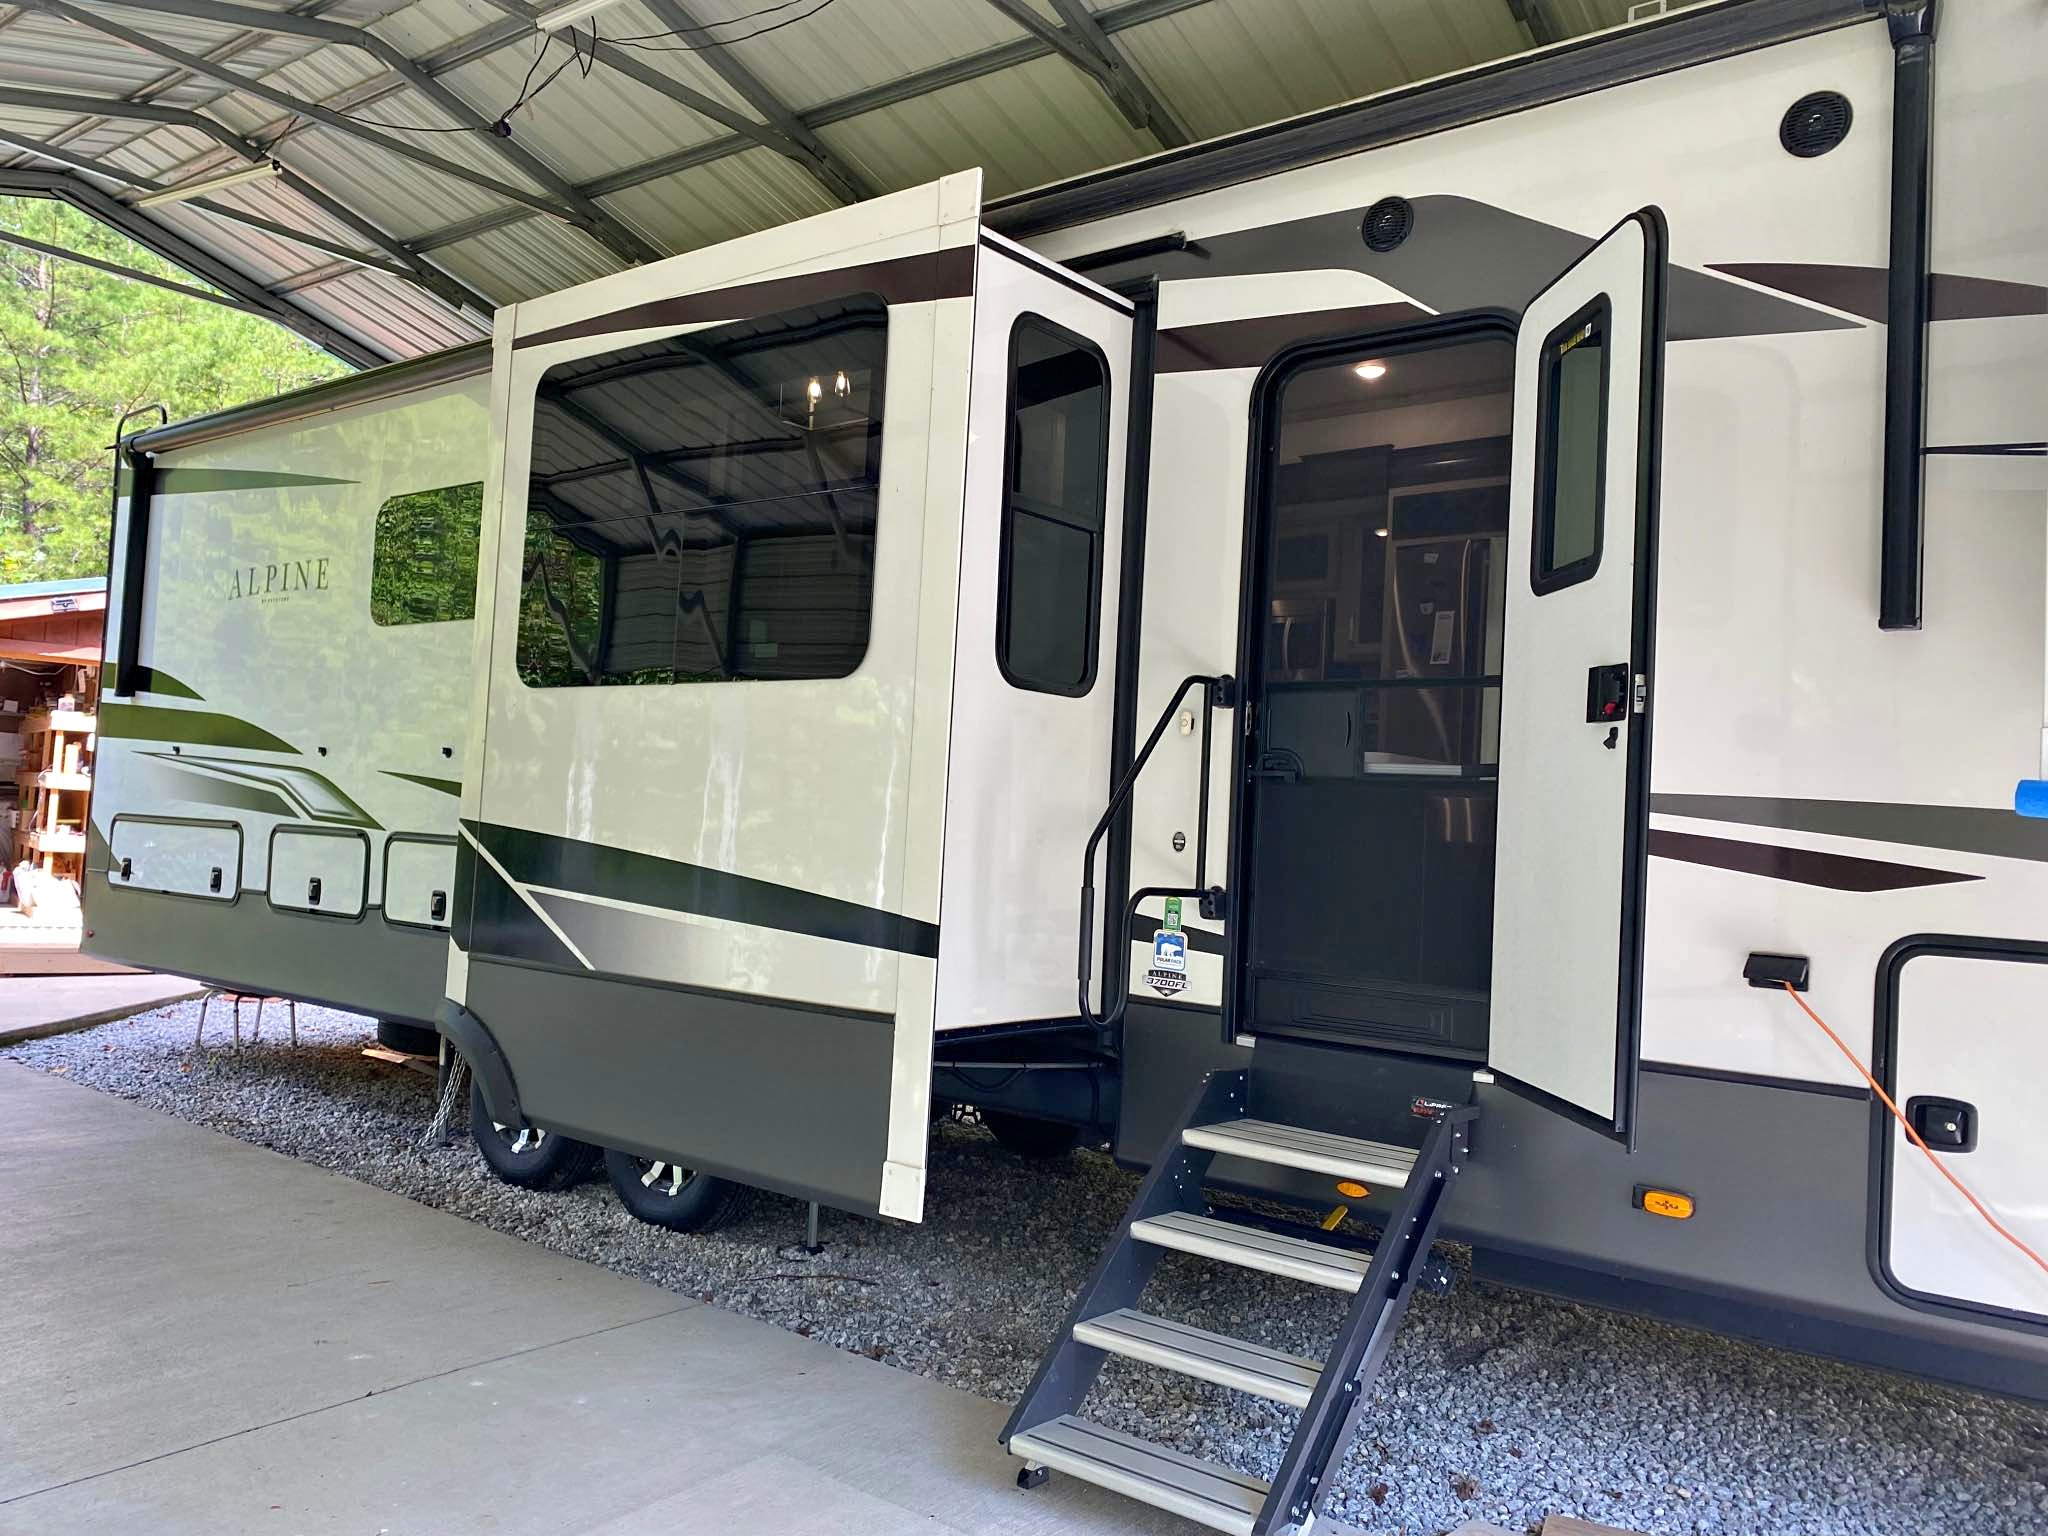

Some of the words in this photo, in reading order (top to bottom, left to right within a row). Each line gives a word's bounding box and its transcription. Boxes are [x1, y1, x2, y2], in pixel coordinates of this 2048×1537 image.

[228, 557, 329, 600] ALPINE
[1151, 971, 1183, 980] ALPINE
[1146, 977, 1188, 989] 3700FL
